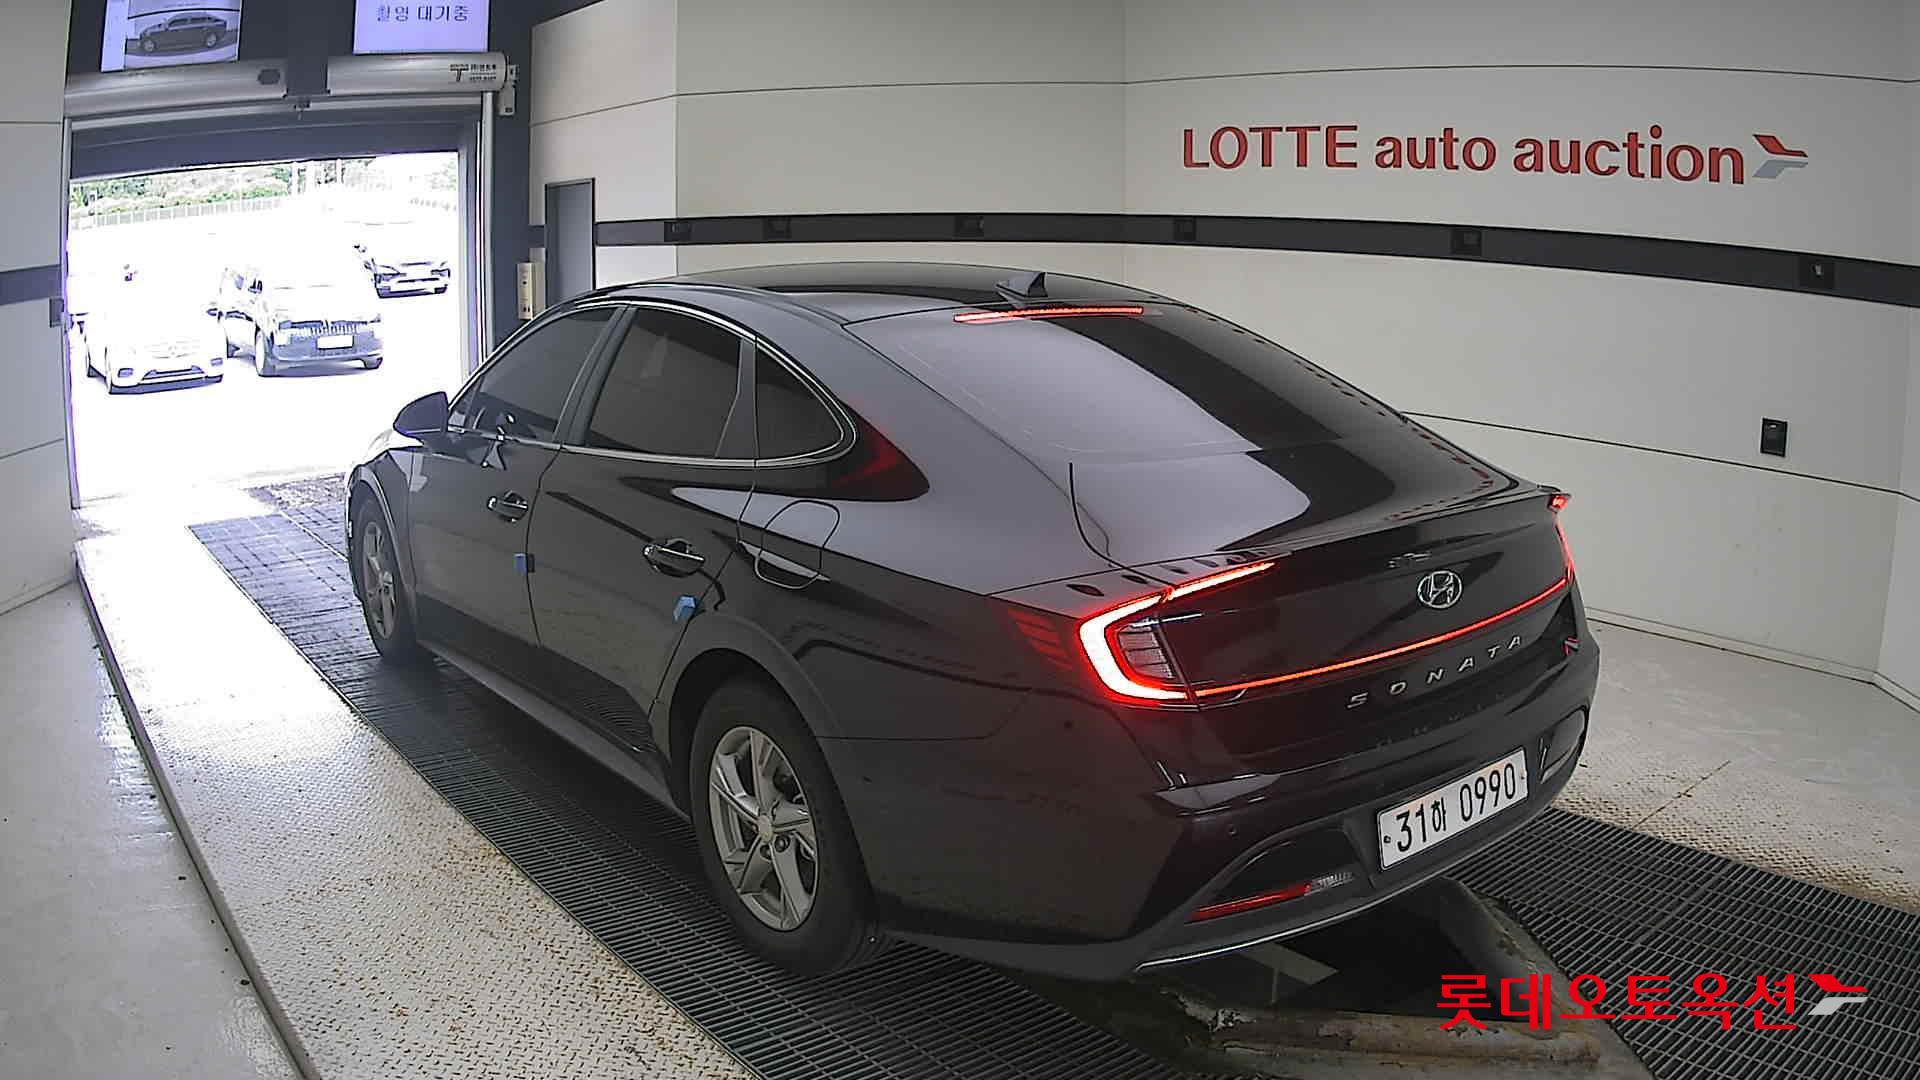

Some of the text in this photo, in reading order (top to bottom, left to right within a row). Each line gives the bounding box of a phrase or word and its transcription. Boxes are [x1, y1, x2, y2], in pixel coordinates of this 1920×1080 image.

[1183, 124, 1744, 184] LOTTE auto auction
[1346, 635, 1523, 709] SONATA
[1396, 763, 1516, 853] 31하 0990
